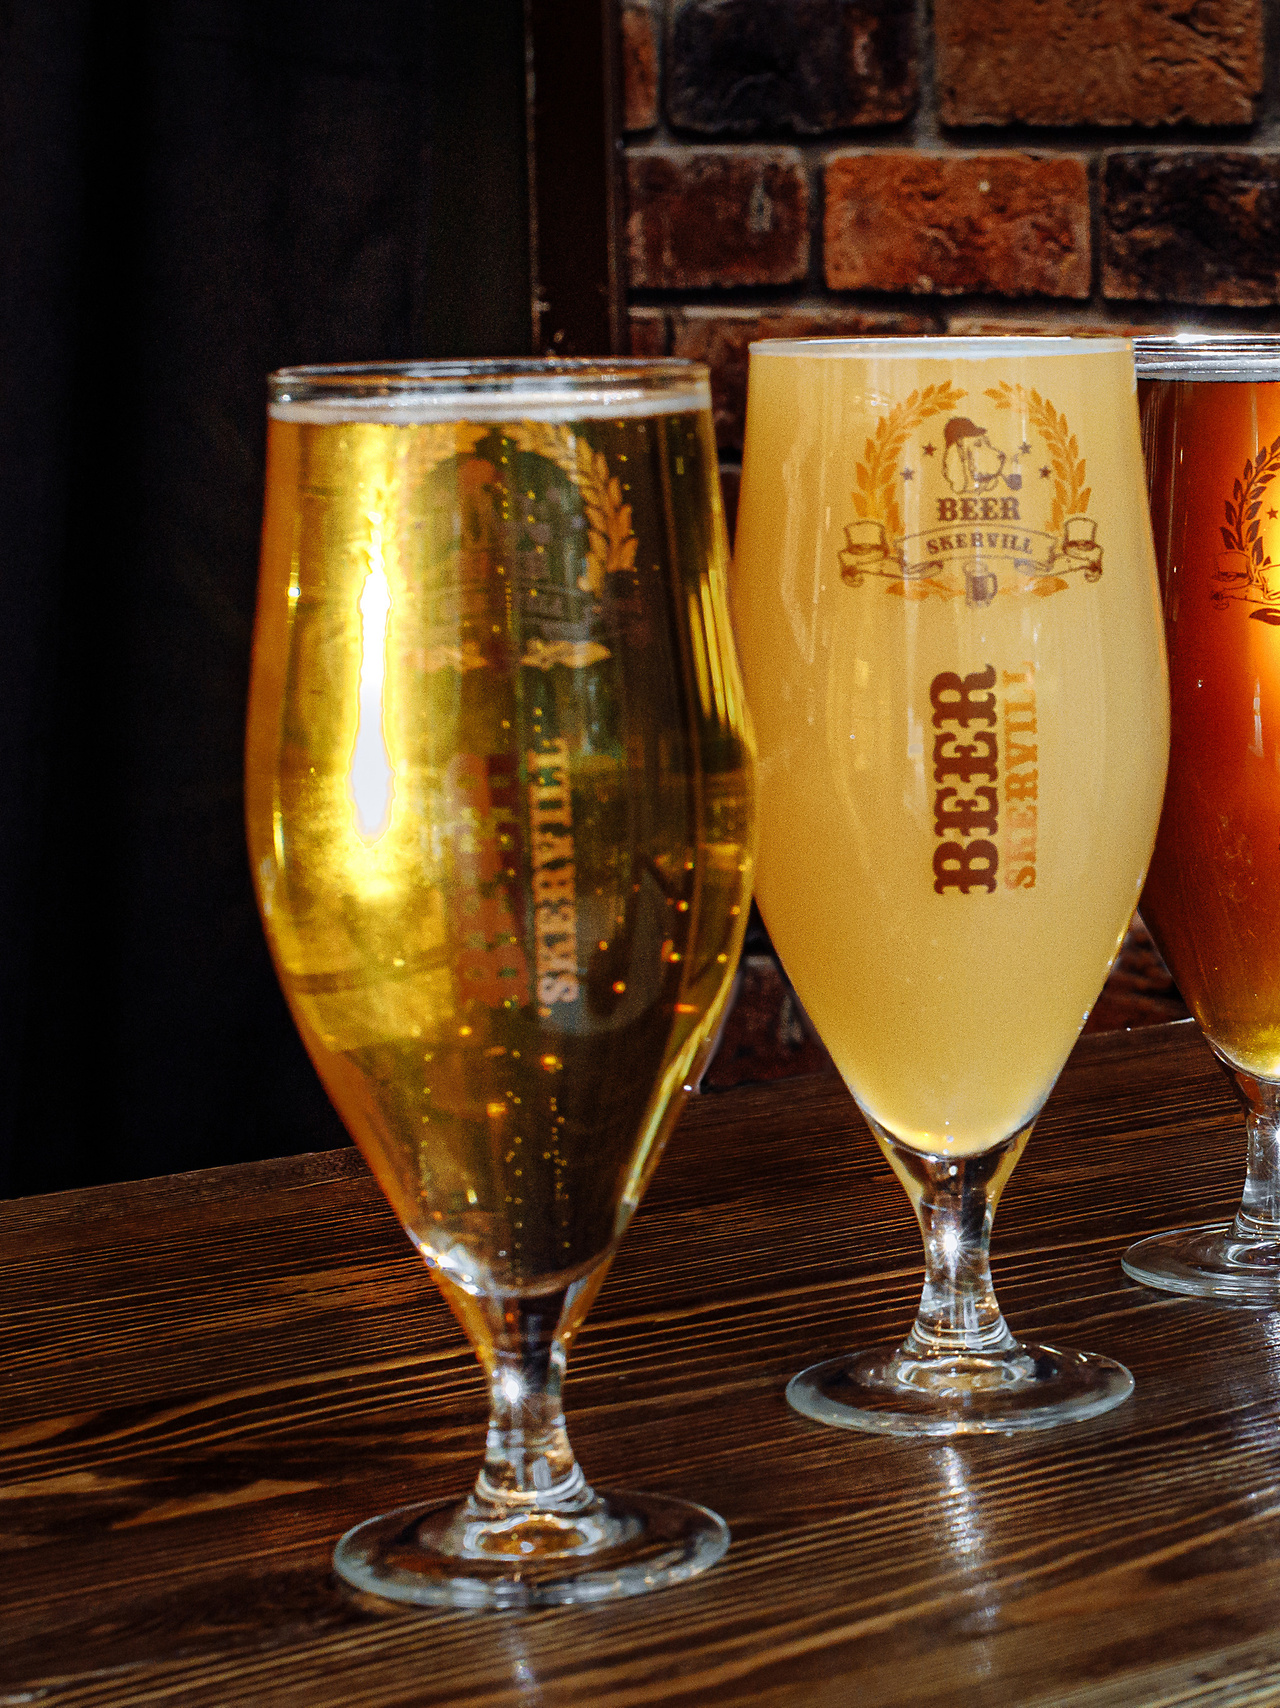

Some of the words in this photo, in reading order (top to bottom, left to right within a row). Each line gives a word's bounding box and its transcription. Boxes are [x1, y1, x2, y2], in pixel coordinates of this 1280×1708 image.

[926, 532, 1033, 555] SKERVILL
[937, 497, 1021, 522] BEER
[527, 737, 579, 1004] SKERVILL
[930, 663, 999, 895] BEER
[1002, 660, 1039, 891] SKERVILL
